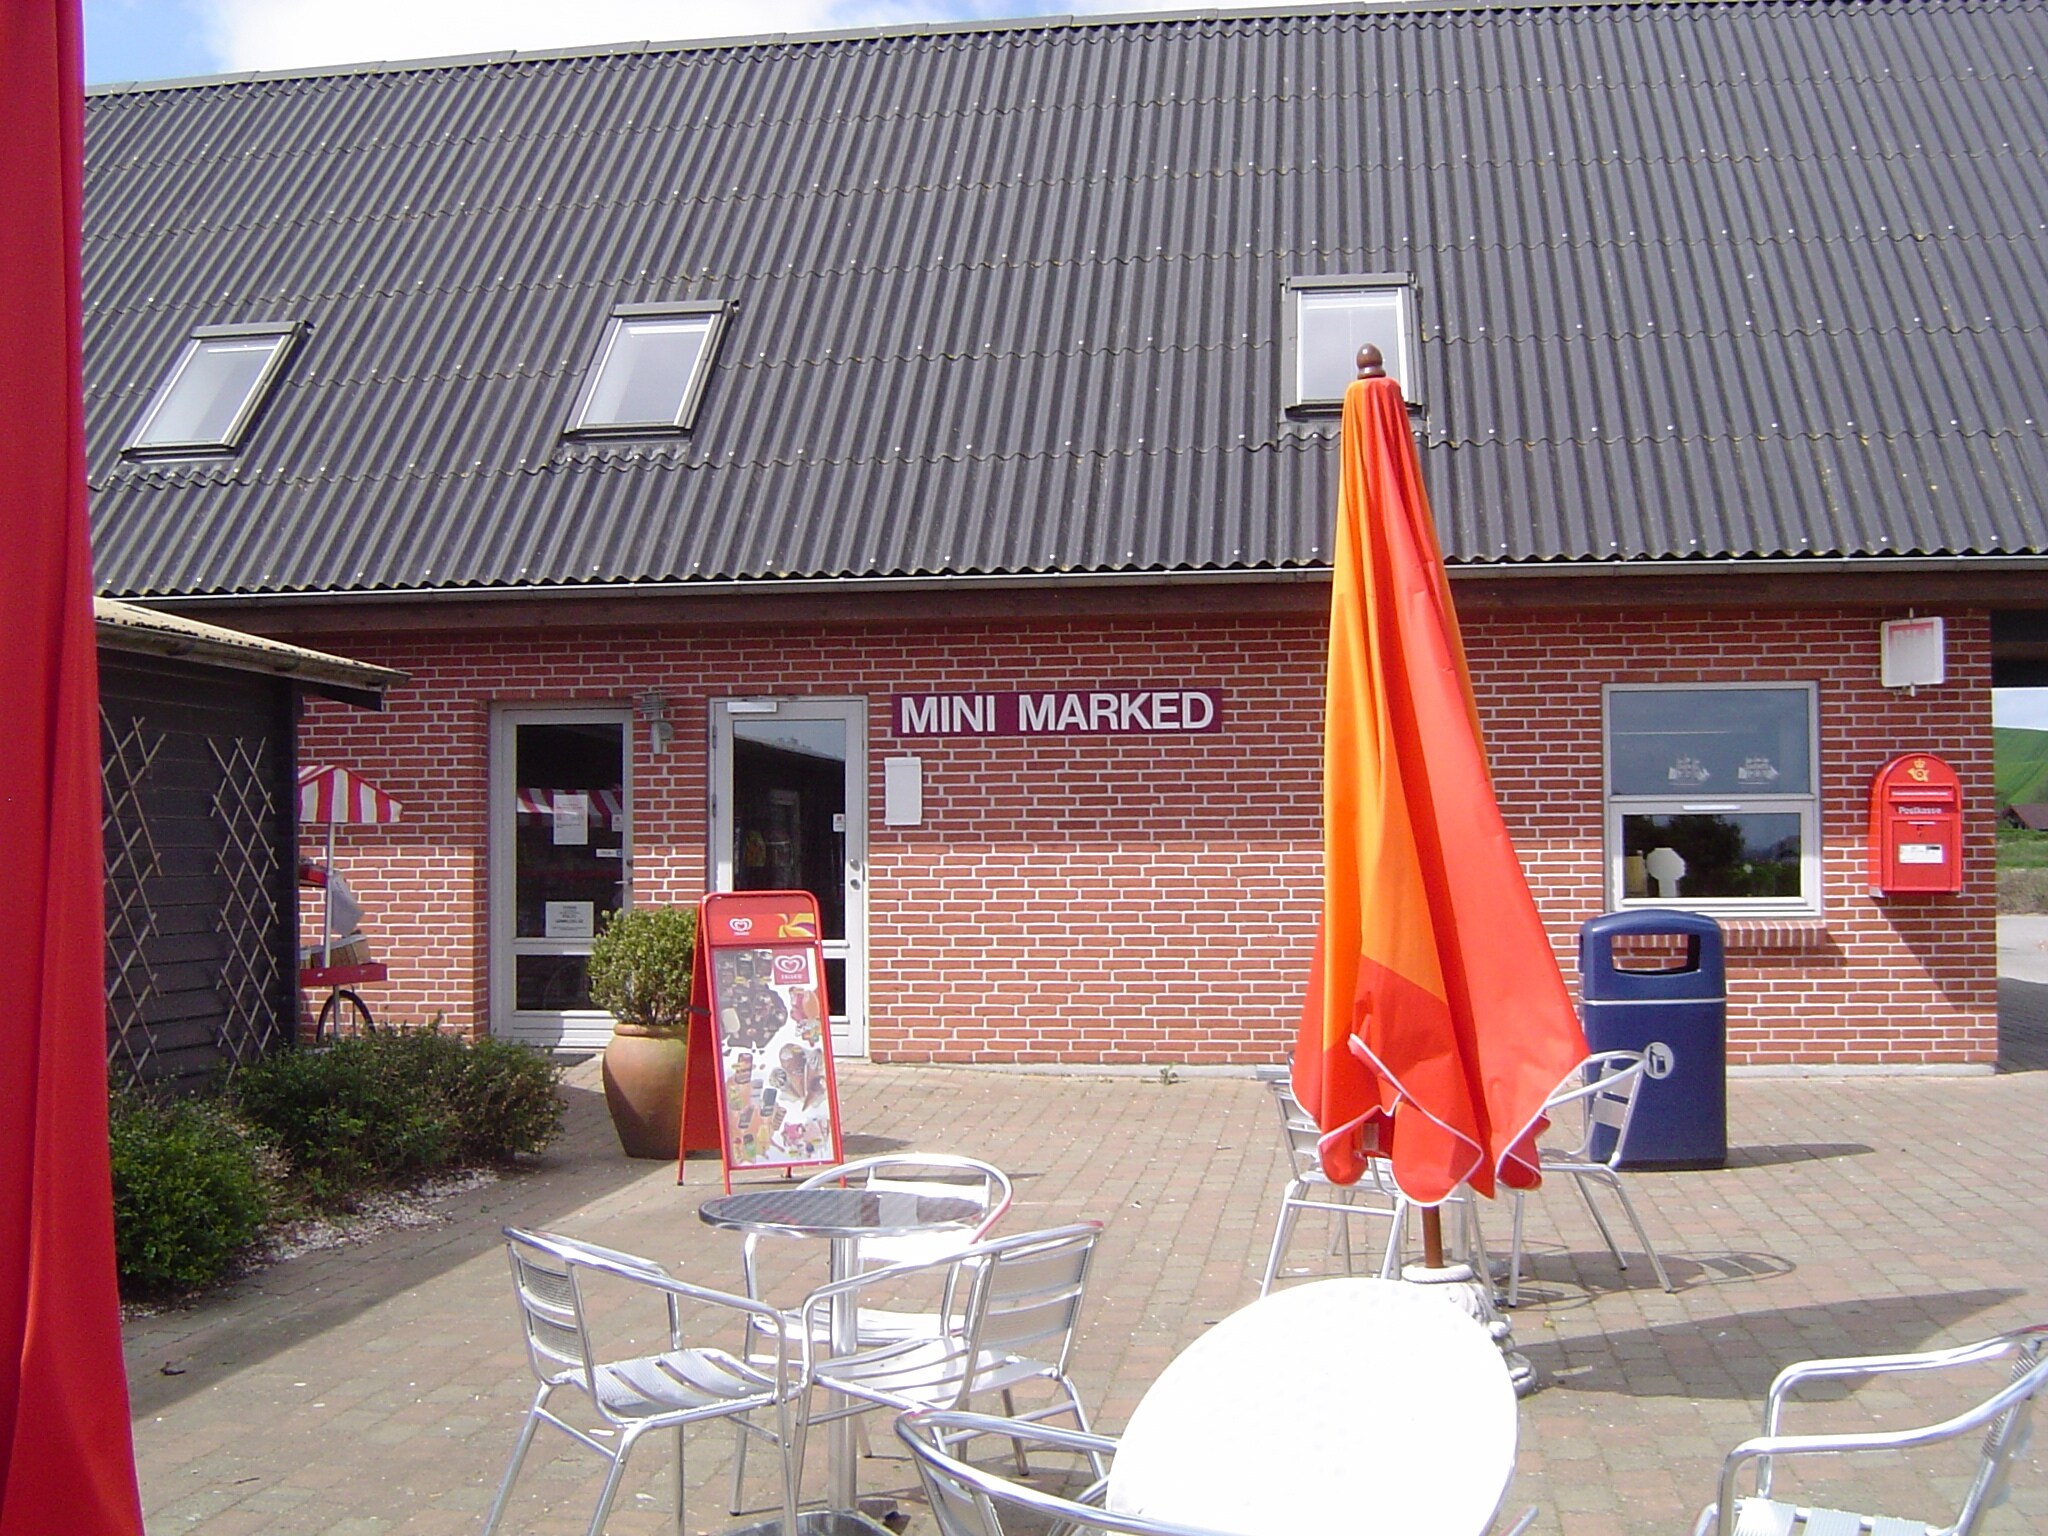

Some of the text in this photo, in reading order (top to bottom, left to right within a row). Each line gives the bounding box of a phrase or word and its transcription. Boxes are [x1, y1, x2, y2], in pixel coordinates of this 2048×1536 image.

[901, 691, 1214, 734] MINI MARKED
[1898, 806, 1942, 815] Postkasse
